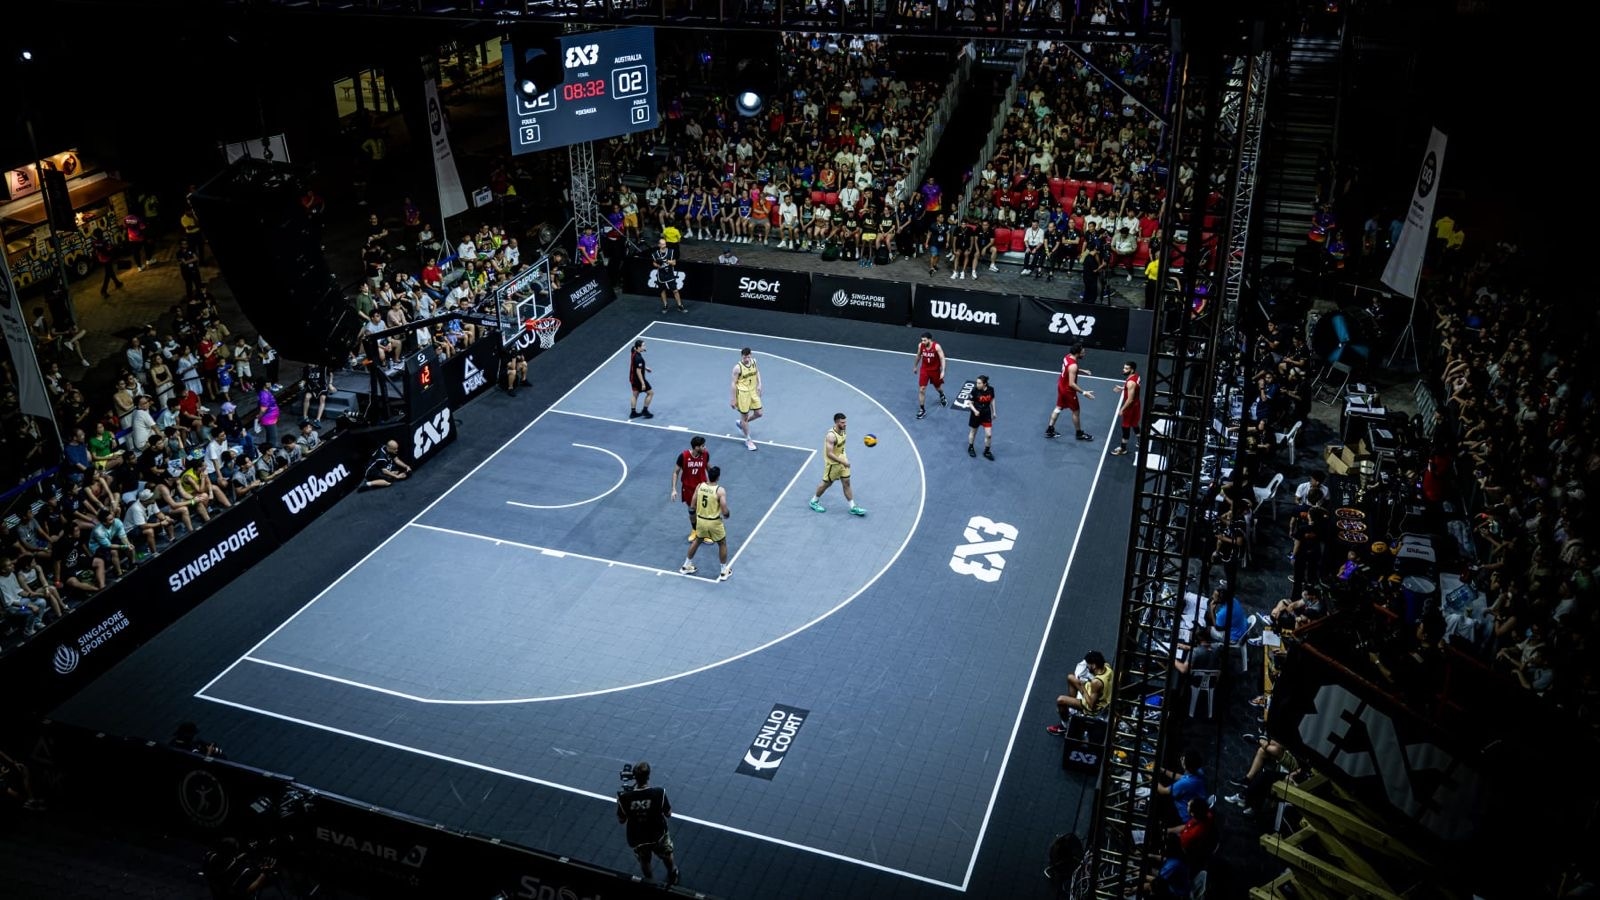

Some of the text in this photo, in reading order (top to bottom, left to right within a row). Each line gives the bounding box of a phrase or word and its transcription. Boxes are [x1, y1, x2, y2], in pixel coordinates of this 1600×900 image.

[614, 53, 642, 64] AUSTRALIA
[563, 79, 605, 101] 08:32
[618, 71, 643, 93] 02
[633, 98, 647, 106] FOULS
[521, 117, 537, 126] FOULS
[636, 108, 645, 120] 0
[525, 128, 535, 140] 3
[738, 276, 781, 294] Sport
[740, 291, 777, 302] SINGAPORE
[850, 299, 886, 309] SPORTS HUB
[851, 292, 885, 303] SINGAPORE
[930, 299, 1000, 326] Wilson
[462, 369, 488, 395] PEAK
[281, 463, 351, 515] Wilson
[702, 494, 708, 508] 5
[168, 520, 260, 593] SINGAPORE
[77, 610, 125, 647] SINGAPORE
[81, 617, 130, 656] SPORTS HUB
[753, 709, 786, 749] ENLIO
[771, 713, 804, 753] COURT
[315, 825, 399, 863] EVA AIR
